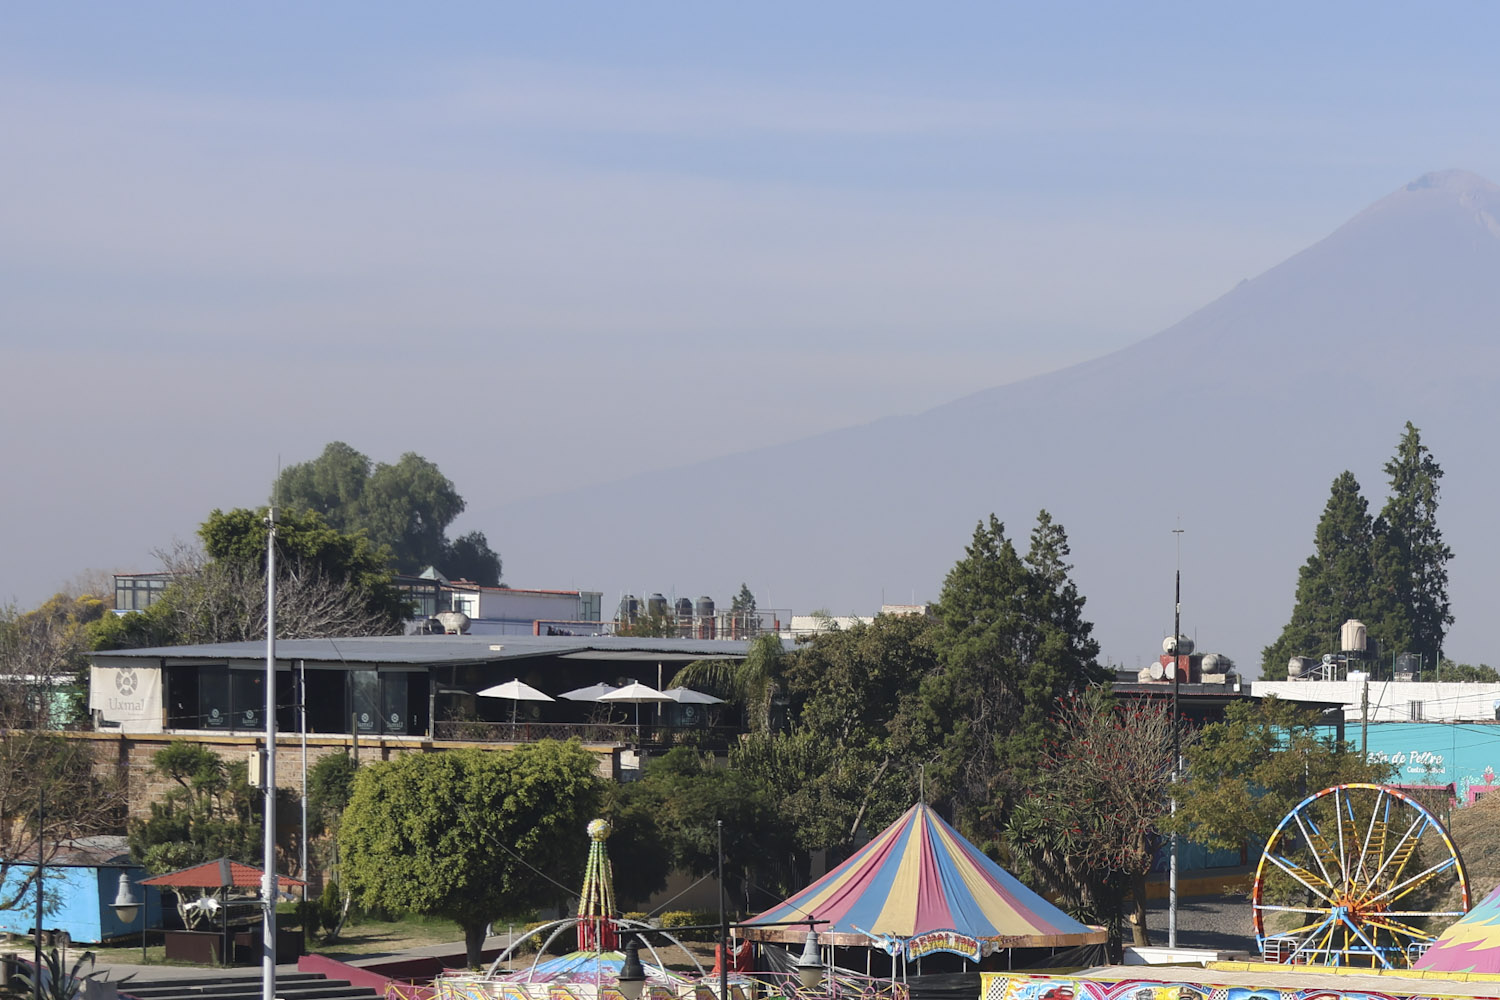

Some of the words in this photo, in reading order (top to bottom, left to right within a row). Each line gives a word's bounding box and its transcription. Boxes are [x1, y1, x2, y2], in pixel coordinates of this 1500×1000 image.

[108, 698, 145, 711] Uxmal
[1391, 751, 1407, 766] de
[1409, 750, 1445, 765] Peltre
